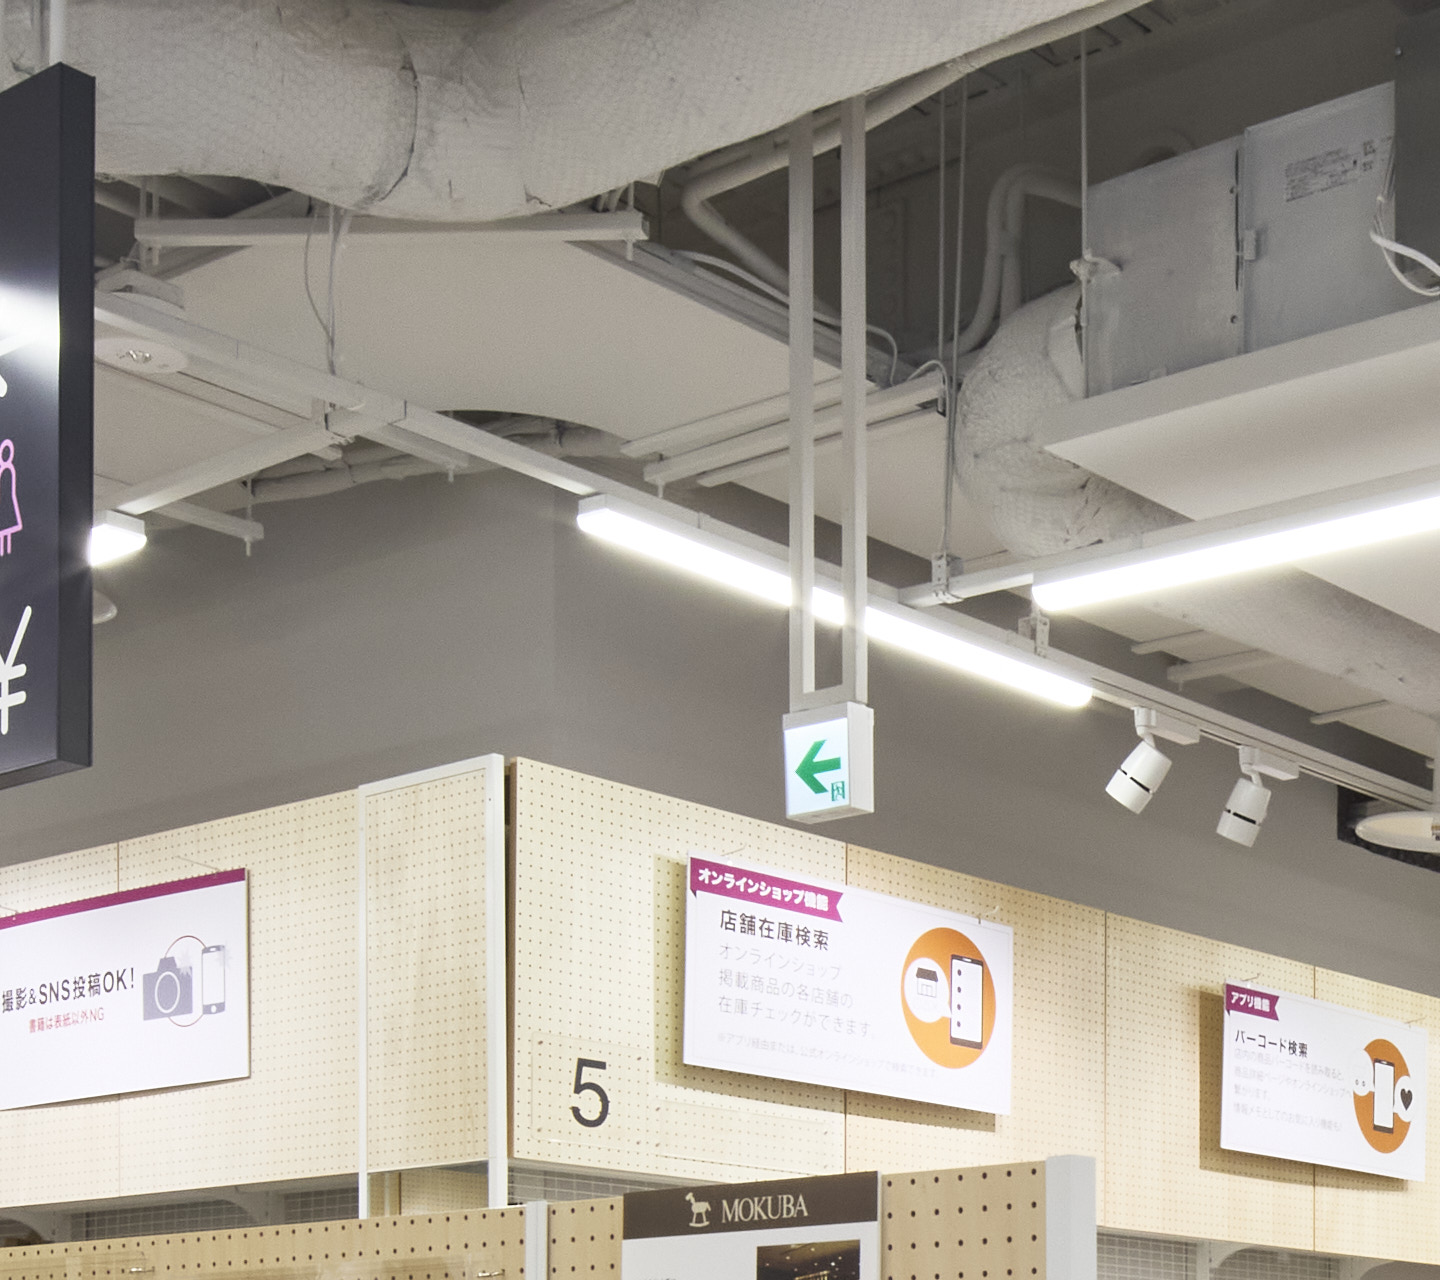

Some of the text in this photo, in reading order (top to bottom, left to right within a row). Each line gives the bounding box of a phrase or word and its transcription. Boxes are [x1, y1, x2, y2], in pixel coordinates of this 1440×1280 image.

[698, 867, 829, 912] オンラインショップ機能
[719, 909, 830, 951] 店舗在庫検索
[718, 943, 843, 981] オンラインショップ
[1235, 1029, 1309, 1058] バーコード検索
[568, 1057, 611, 1129] 5
[721, 1193, 809, 1224] MOKUBA
